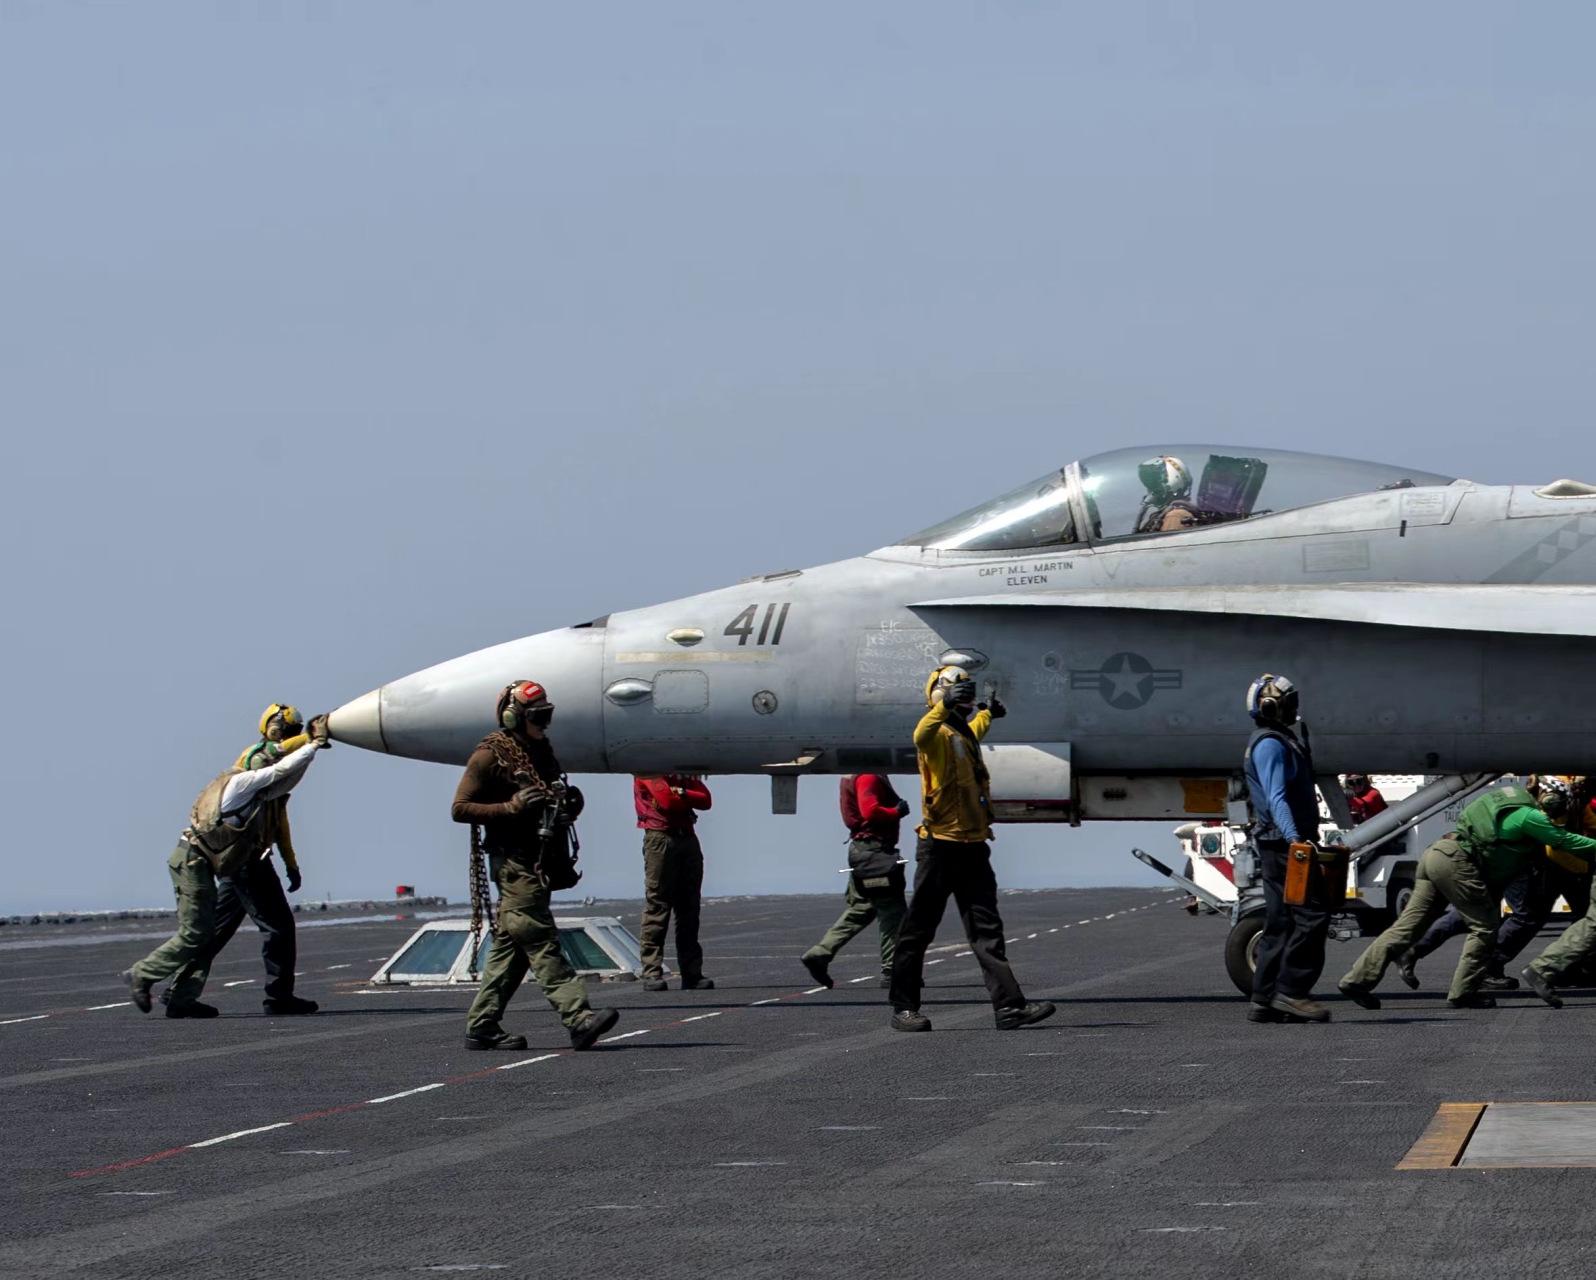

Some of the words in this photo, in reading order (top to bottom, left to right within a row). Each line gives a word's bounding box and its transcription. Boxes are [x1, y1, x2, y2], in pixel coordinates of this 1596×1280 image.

[979, 567, 1004, 577] CAPT
[1034, 562, 1073, 572] MARTIN
[1007, 576, 1047, 586] ELEVEN
[724, 603, 791, 646] 411
